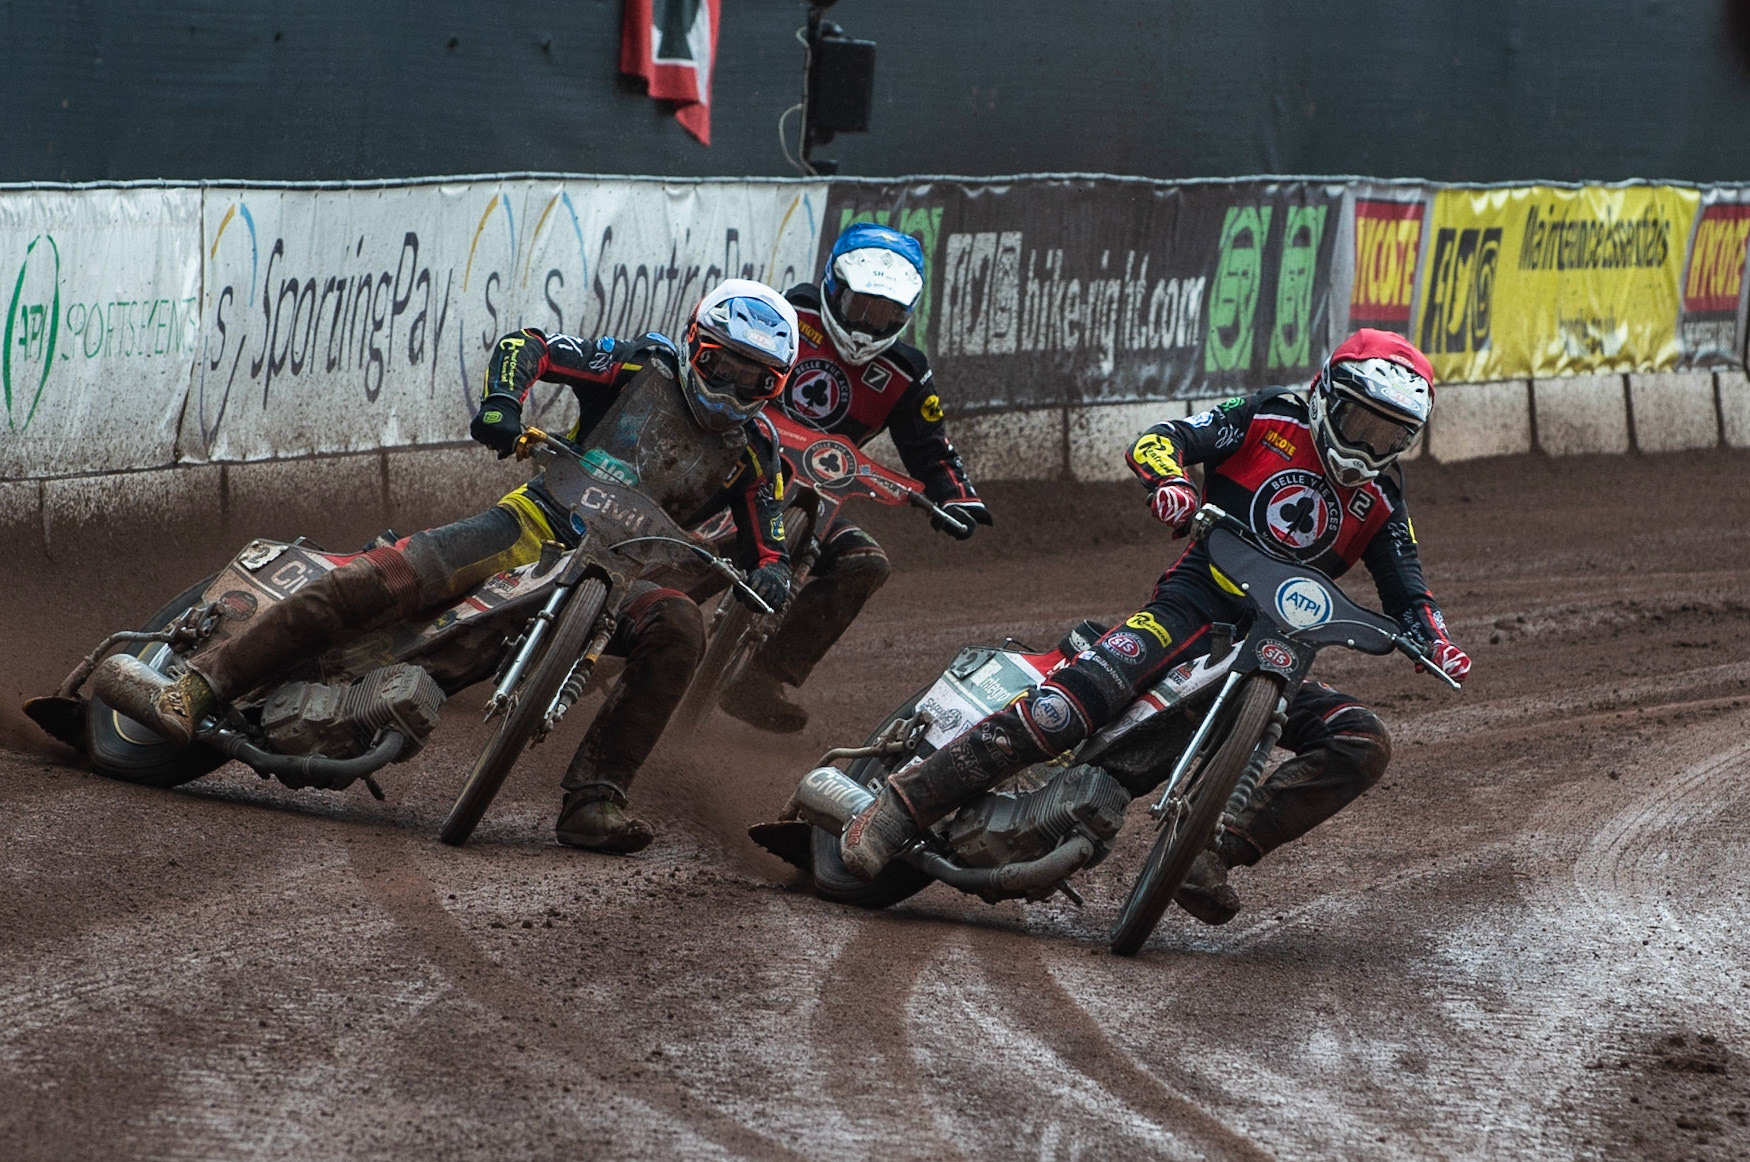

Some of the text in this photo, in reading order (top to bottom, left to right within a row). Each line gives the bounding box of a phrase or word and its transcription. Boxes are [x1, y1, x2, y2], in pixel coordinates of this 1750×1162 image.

[795, 361, 820, 375] BELLE
[824, 361, 841, 378] VUE
[868, 366, 887, 383] 7
[580, 486, 646, 533] Civil
[1271, 474, 1305, 491] BELLE
[1326, 500, 1340, 532] ACES
[1352, 492, 1371, 516] 2
[1286, 591, 1322, 617] ATPI
[957, 651, 979, 672] 2
[1265, 648, 1287, 665] STS
[1041, 702, 1062, 725] ATPI
